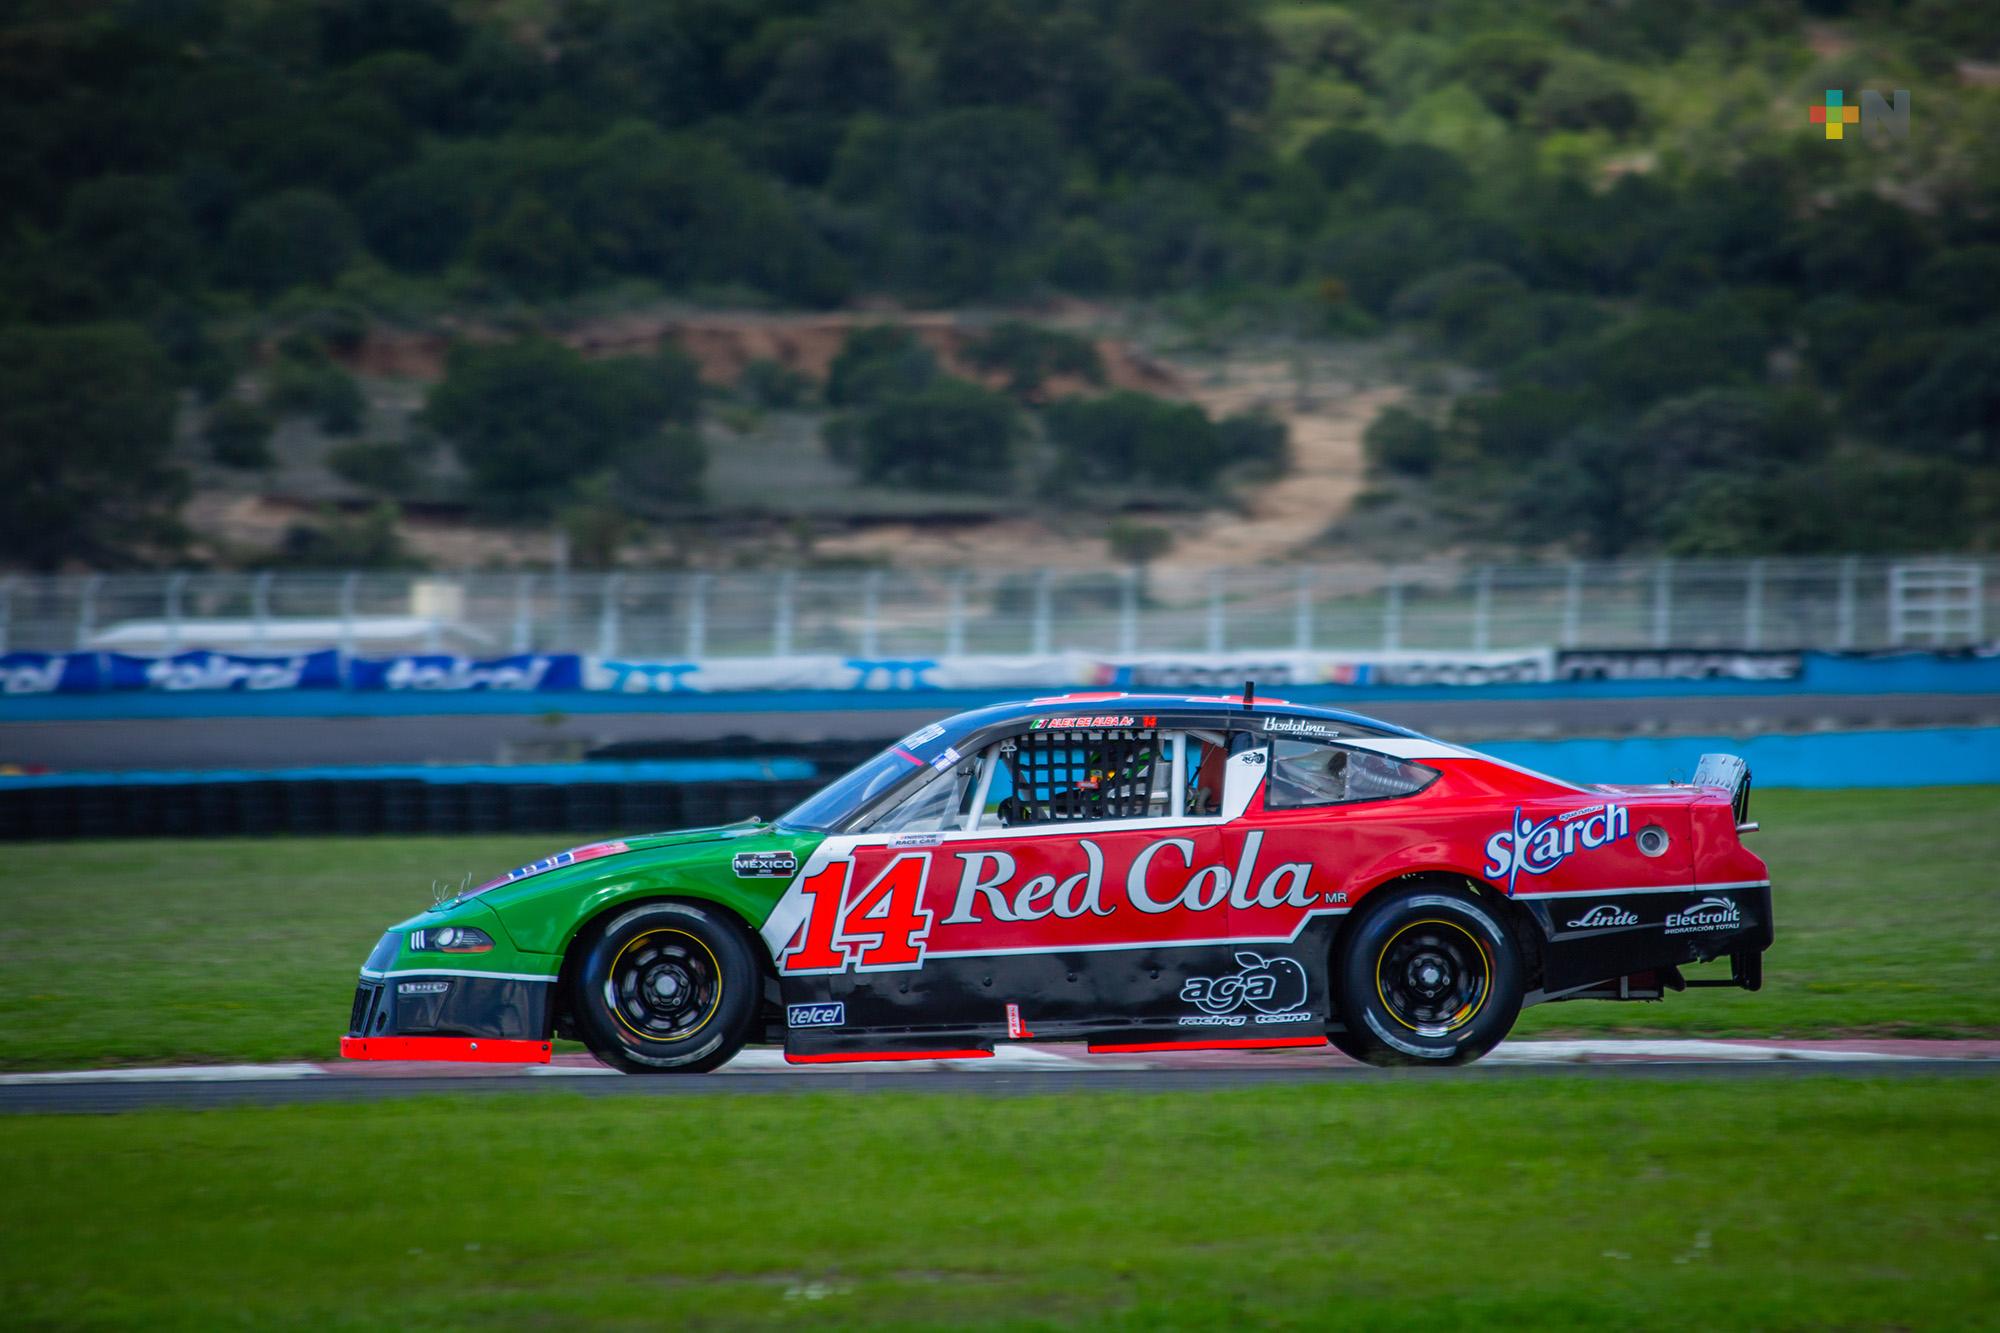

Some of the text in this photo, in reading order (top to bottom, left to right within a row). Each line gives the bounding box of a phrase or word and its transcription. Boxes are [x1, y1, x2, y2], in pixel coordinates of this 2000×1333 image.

[1048, 717, 1077, 729] ALEX
[1076, 717, 1092, 728] DE
[1092, 715, 1119, 728] ALBA
[735, 858, 795, 869] MÉXICO
[939, 829, 1348, 926] Red Cola MR
[781, 854, 930, 974] 14
[1566, 904, 1639, 928] Linde
[1665, 906, 1740, 927] Electrolit
[1180, 975, 1277, 1014] aga
[789, 1005, 842, 1026] telcel
[1179, 1012, 1311, 1026] racing team
